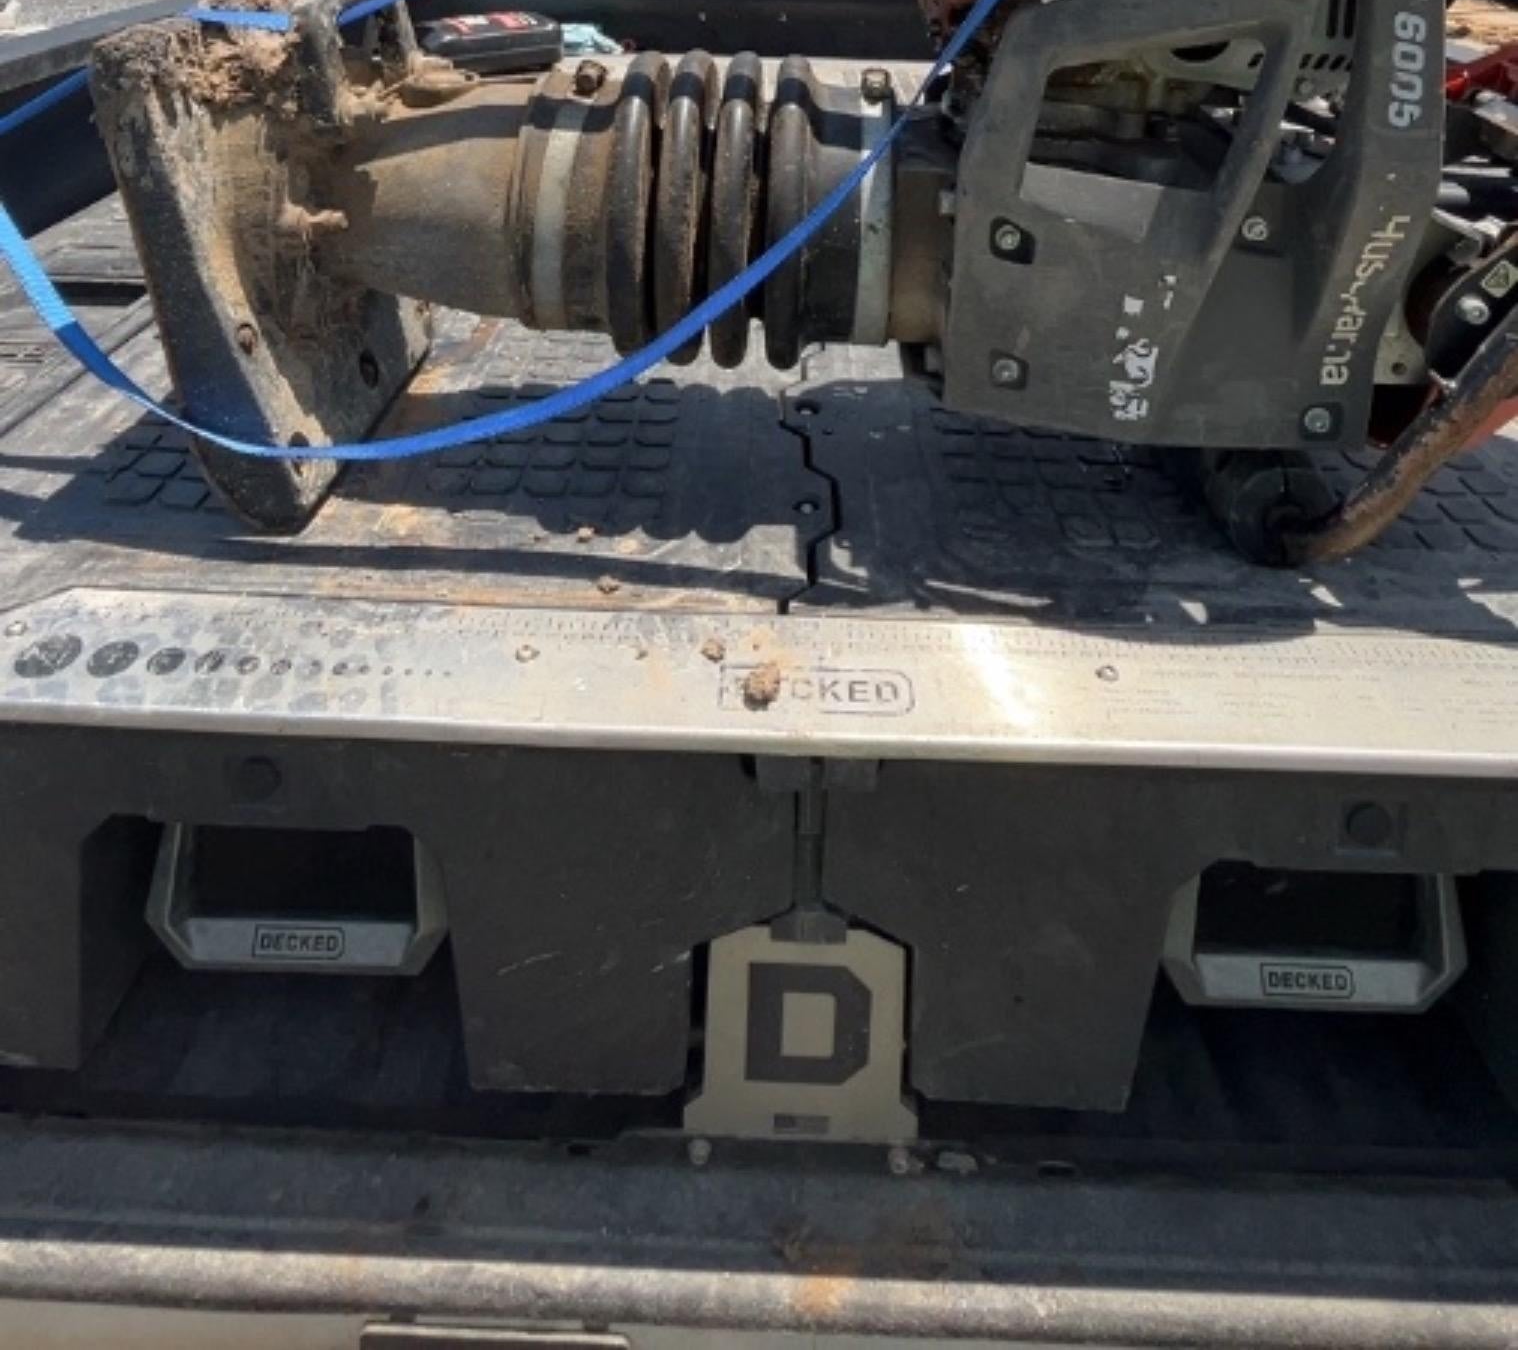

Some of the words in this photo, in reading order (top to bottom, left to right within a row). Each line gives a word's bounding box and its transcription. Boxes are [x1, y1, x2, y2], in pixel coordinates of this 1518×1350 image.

[1388, 11, 1426, 127] 6005
[730, 675, 899, 703] CKED
[260, 932, 338, 952] DECKED
[1268, 971, 1347, 991] DECKED
[744, 963, 873, 1087] D
